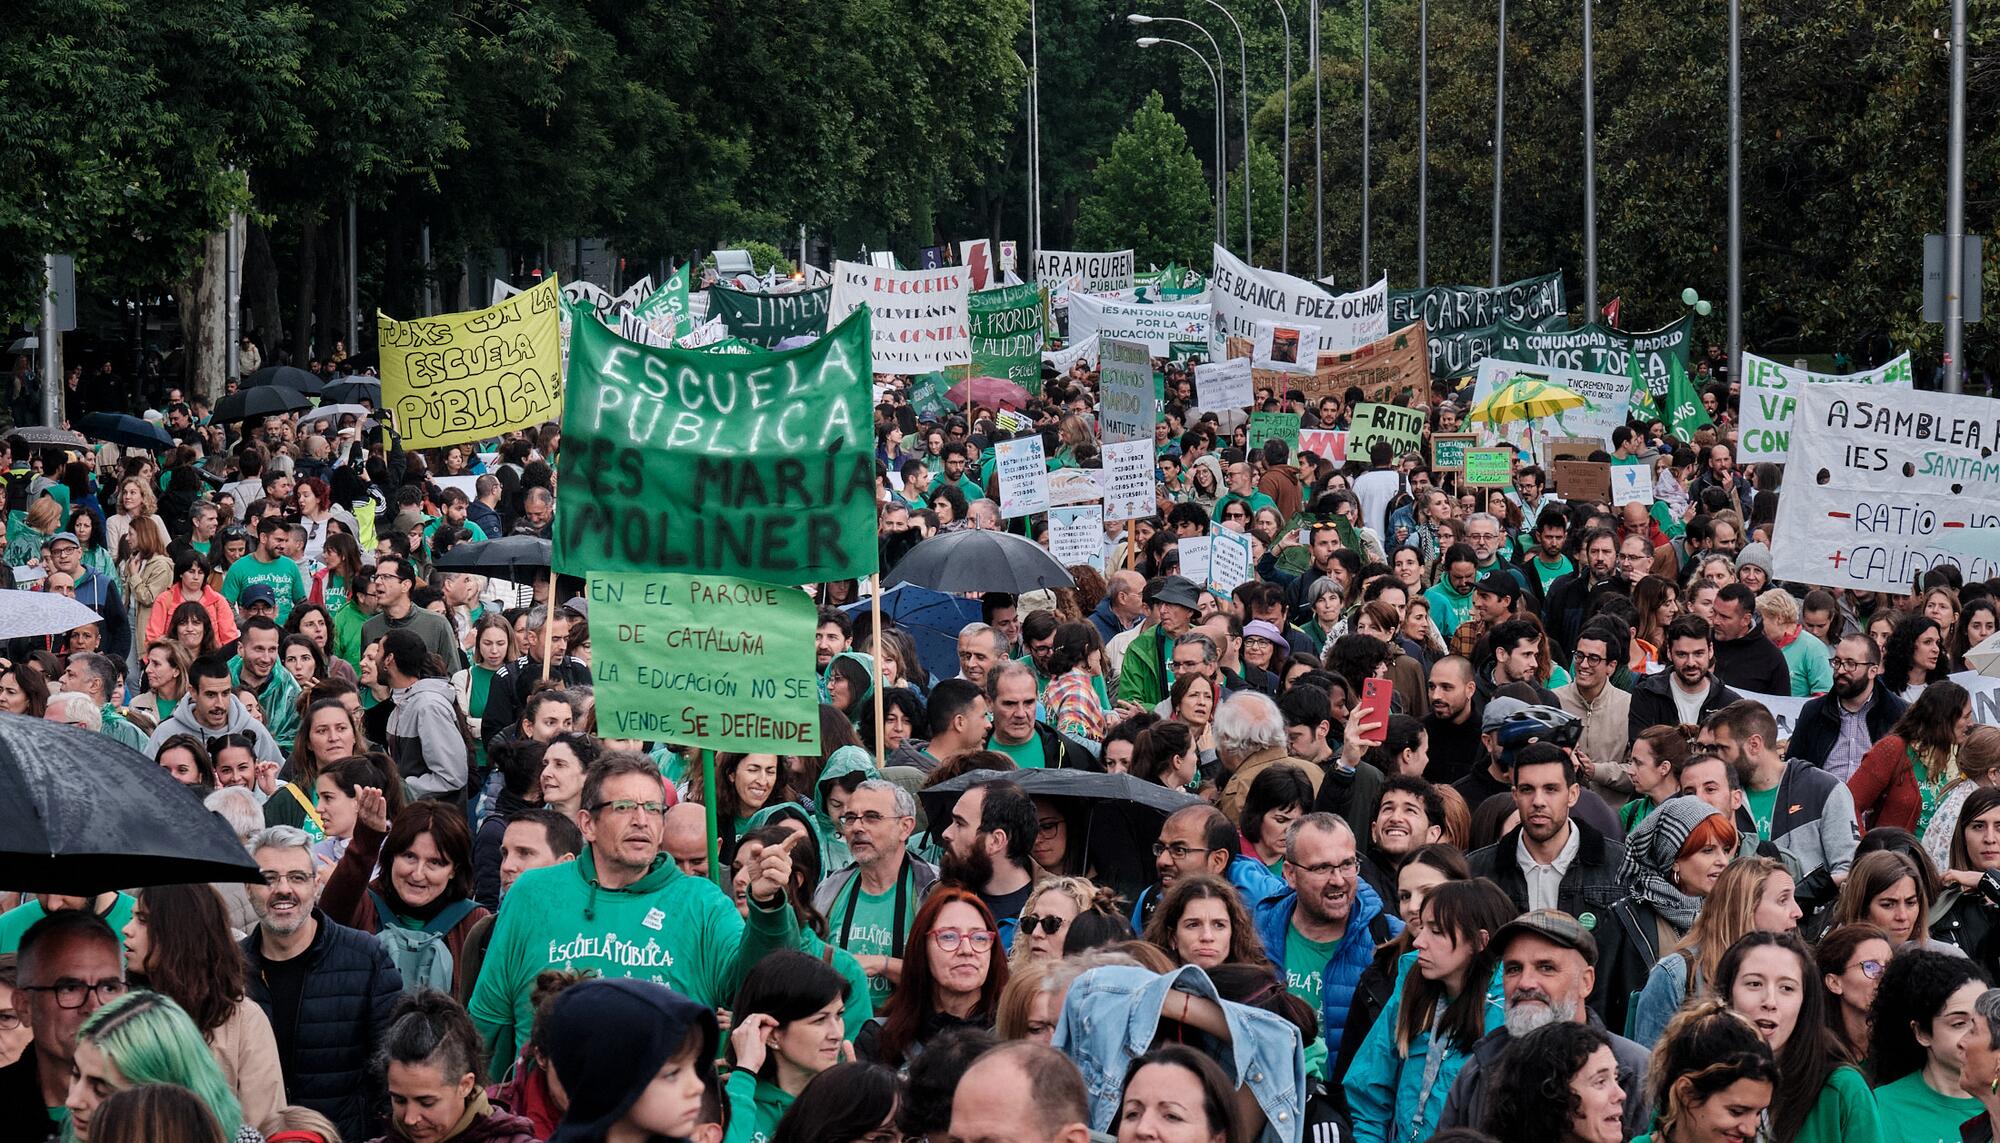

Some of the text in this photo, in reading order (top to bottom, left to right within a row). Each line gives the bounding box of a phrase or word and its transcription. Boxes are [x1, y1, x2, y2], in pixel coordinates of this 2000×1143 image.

[1037, 254, 1133, 279] ARANGUREN
[846, 272, 959, 295] LOS RECORTES
[1090, 280, 1129, 291] PÚBLICA
[1213, 263, 1233, 293] IES
[1233, 276, 1286, 313] BLANCA
[1295, 295, 1339, 320] FDEZ.
[1341, 292, 1384, 319] OCHOA
[532, 287, 556, 314] LA
[1102, 305, 1120, 315] IES
[1122, 308, 1174, 318] ANTONIO
[1393, 278, 1568, 332] EL CARRASCAL
[900, 324, 968, 344] CONTRA
[1136, 319, 1178, 328] POR LA
[1503, 330, 1684, 351] LA COMUNIDAD DE MADRID
[405, 333, 536, 388] ESCUELA
[1748, 359, 1788, 390] IES
[601, 340, 857, 414] ESCUELA
[1328, 365, 1401, 391] DESTINO
[1567, 378, 1614, 393] INCREMENTO
[396, 367, 552, 440] PÚBLICA
[1105, 419, 1136, 436] MATUTE
[1371, 405, 1424, 435] RATIO
[1827, 400, 1981, 450] ASAMBLEA
[693, 435, 876, 507] MARÍA
[1845, 445, 1889, 471] IES
[570, 501, 850, 570] MOLINER
[1184, 545, 1209, 556] HARTAS
[592, 579, 778, 606] EN EL PARQUE
[618, 624, 764, 656] DE CATALUÑA
[598, 661, 619, 682] LA
[751, 679, 776, 699] NO
[784, 678, 811, 698] SE
[615, 706, 813, 743] VENDE, SE DEFIENDE
[549, 934, 612, 963] ESCUELA
